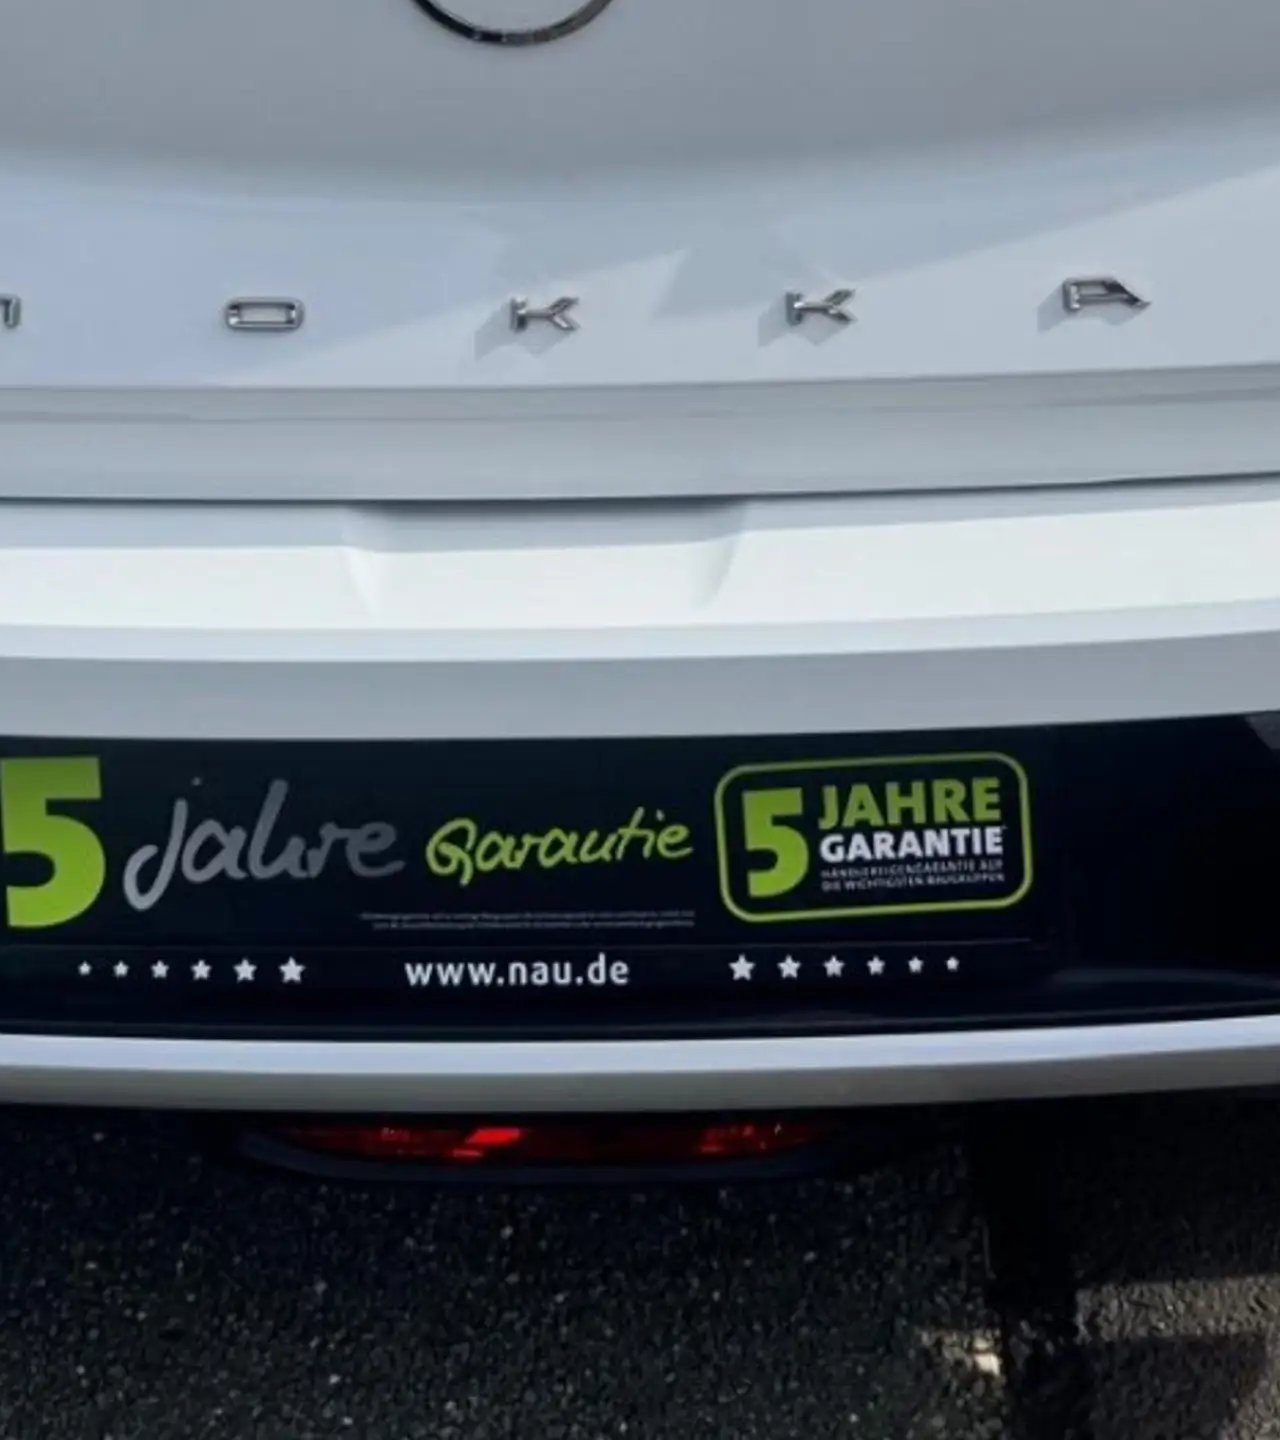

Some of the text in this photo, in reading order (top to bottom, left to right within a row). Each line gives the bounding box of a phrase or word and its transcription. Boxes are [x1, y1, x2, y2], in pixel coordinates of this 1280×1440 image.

[743, 777, 1002, 898] 5 JAHRE
[820, 826, 1004, 863] GARANTIE
[404, 953, 629, 986] www.nau.de
